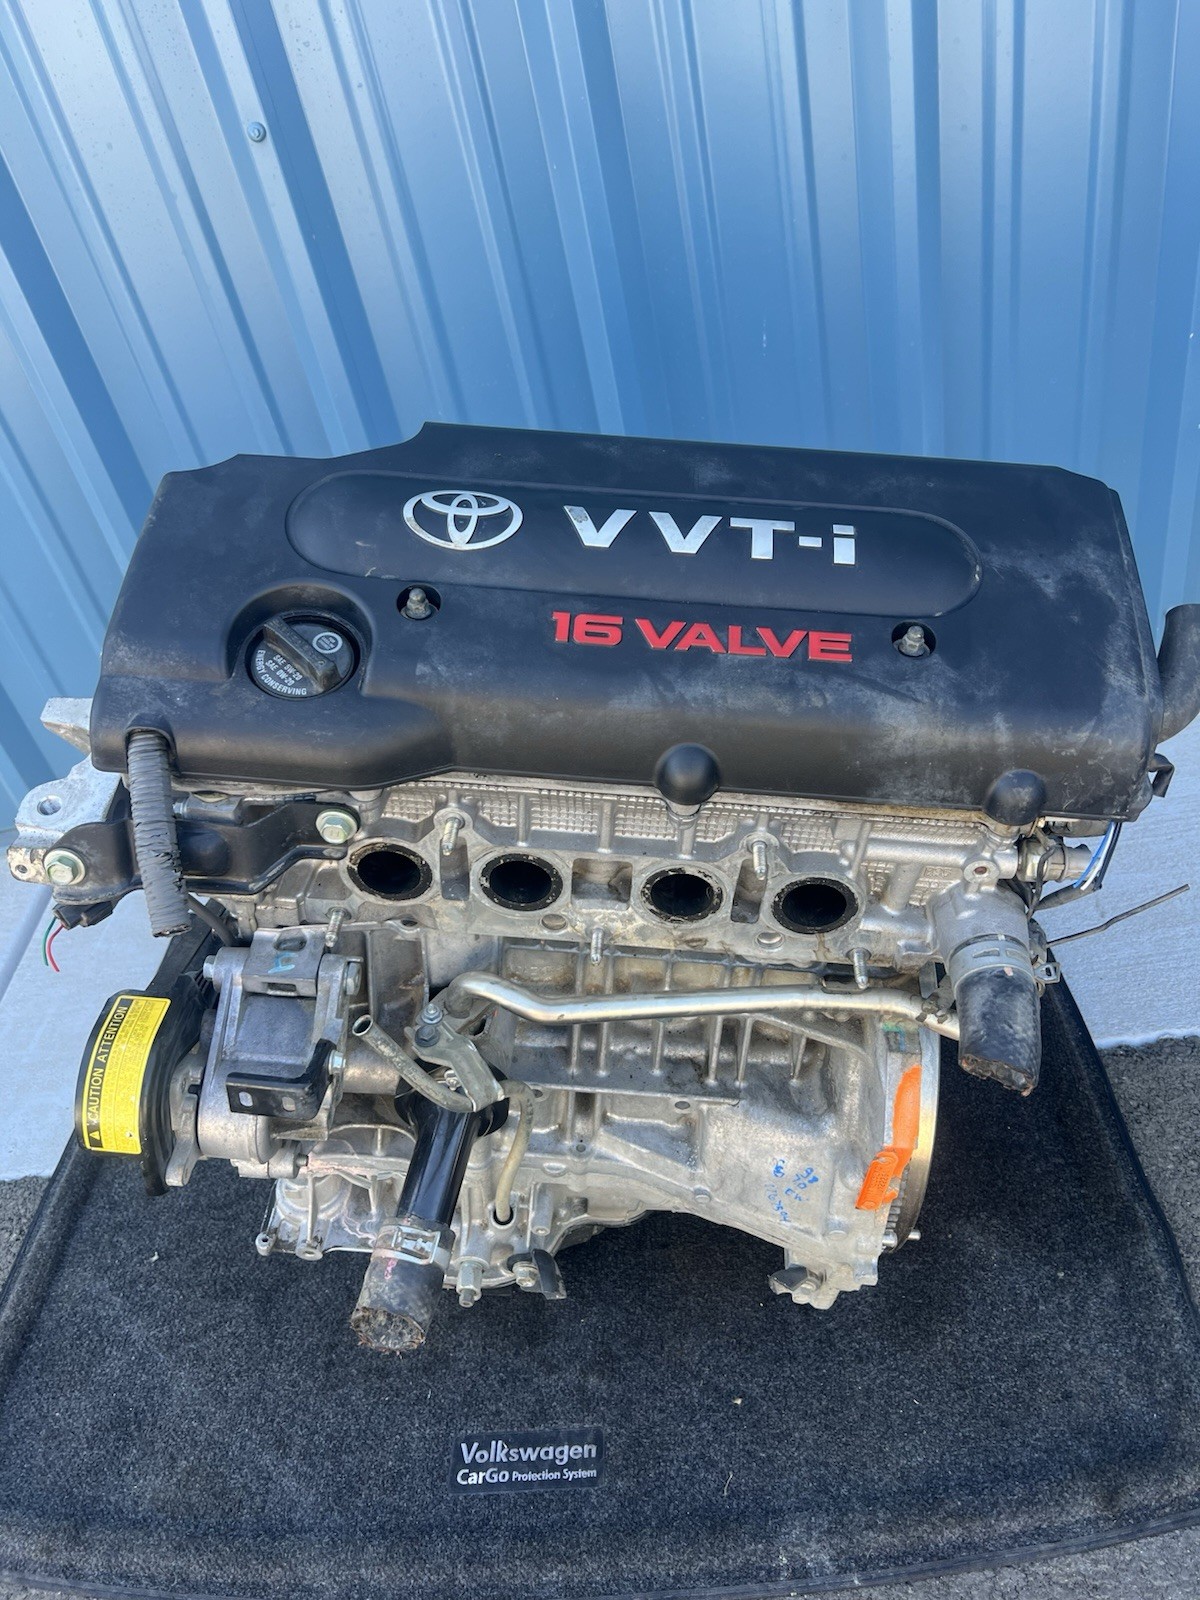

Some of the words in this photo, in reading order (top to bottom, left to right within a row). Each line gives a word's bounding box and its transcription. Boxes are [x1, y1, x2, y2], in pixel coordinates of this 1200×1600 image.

[563, 505, 856, 565] VVT-i
[552, 611, 624, 645] 16
[635, 618, 853, 662] VALVE
[256, 650, 266, 674] ENERGY
[261, 674, 307, 695] CONSERVING
[265, 659, 279, 672] SAE
[273, 654, 287, 667] SAE
[284, 663, 303, 681] 5W-20
[87, 1067, 104, 1123] CAUTION
[97, 1006, 128, 1064] ATTENTION
[460, 1440, 597, 1466] Volkswagen
[456, 1467, 510, 1485] CarGo
[511, 1468, 561, 1482] Protection
[562, 1468, 597, 1482] System
